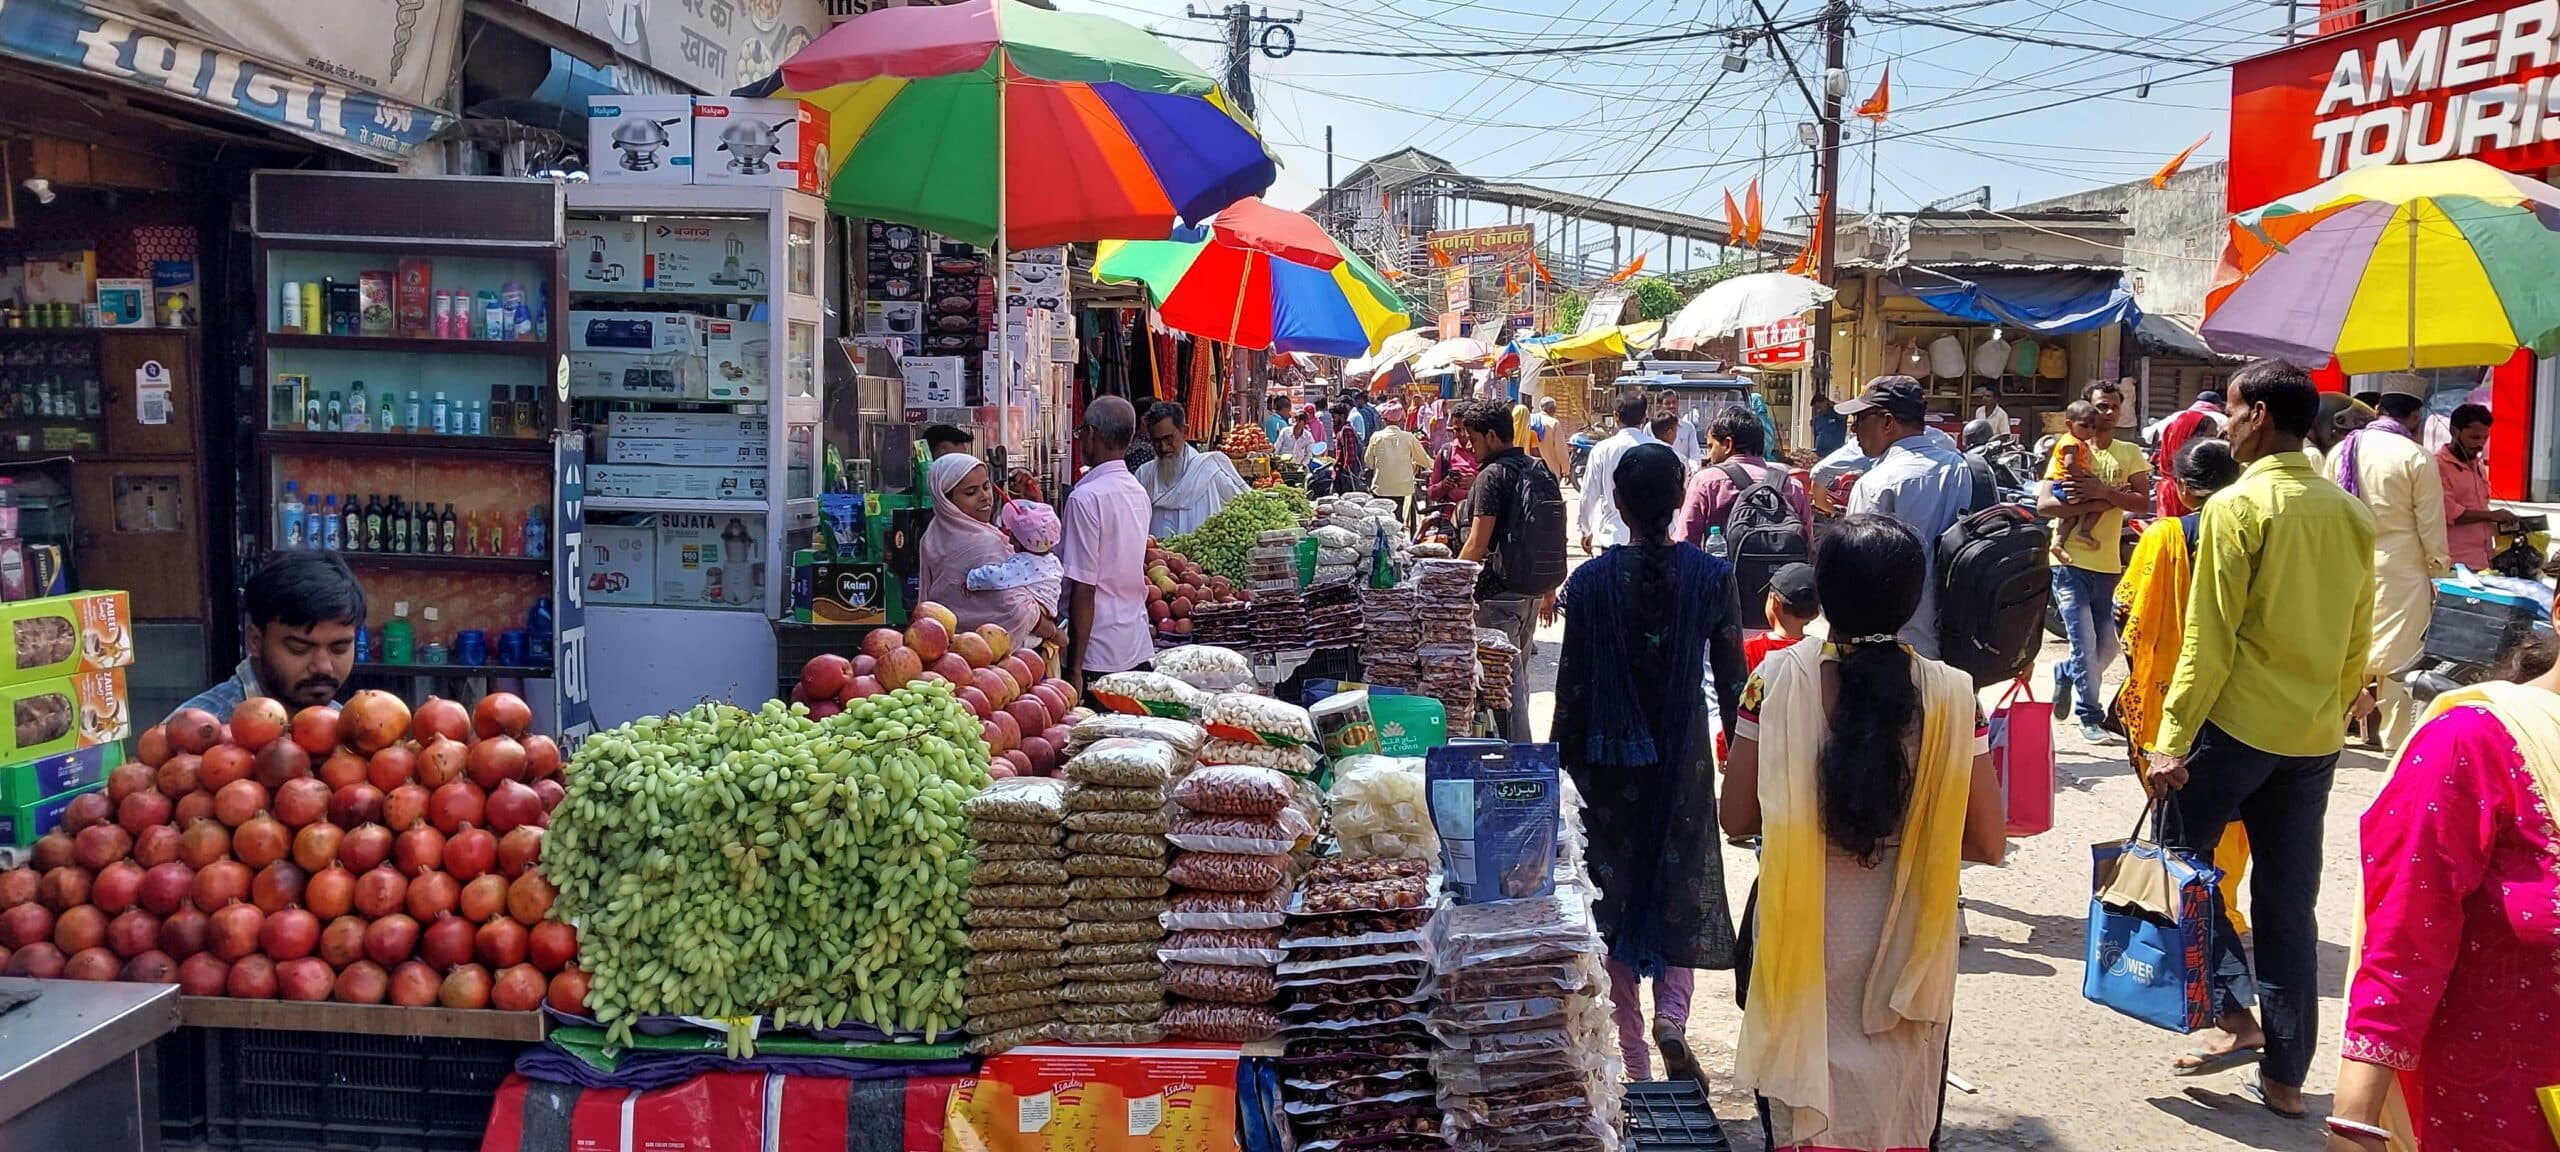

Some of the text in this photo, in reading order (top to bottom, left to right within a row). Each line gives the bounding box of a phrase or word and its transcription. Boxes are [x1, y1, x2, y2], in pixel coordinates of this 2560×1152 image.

[680, 26, 728, 79] खाना
[2315, 0, 2560, 115] AMER
[701, 107, 726, 117] Kalyan
[662, 514, 715, 528] SUJATA
[843, 580, 870, 590] Kalmi
[1498, 783, 1541, 798] البراري
